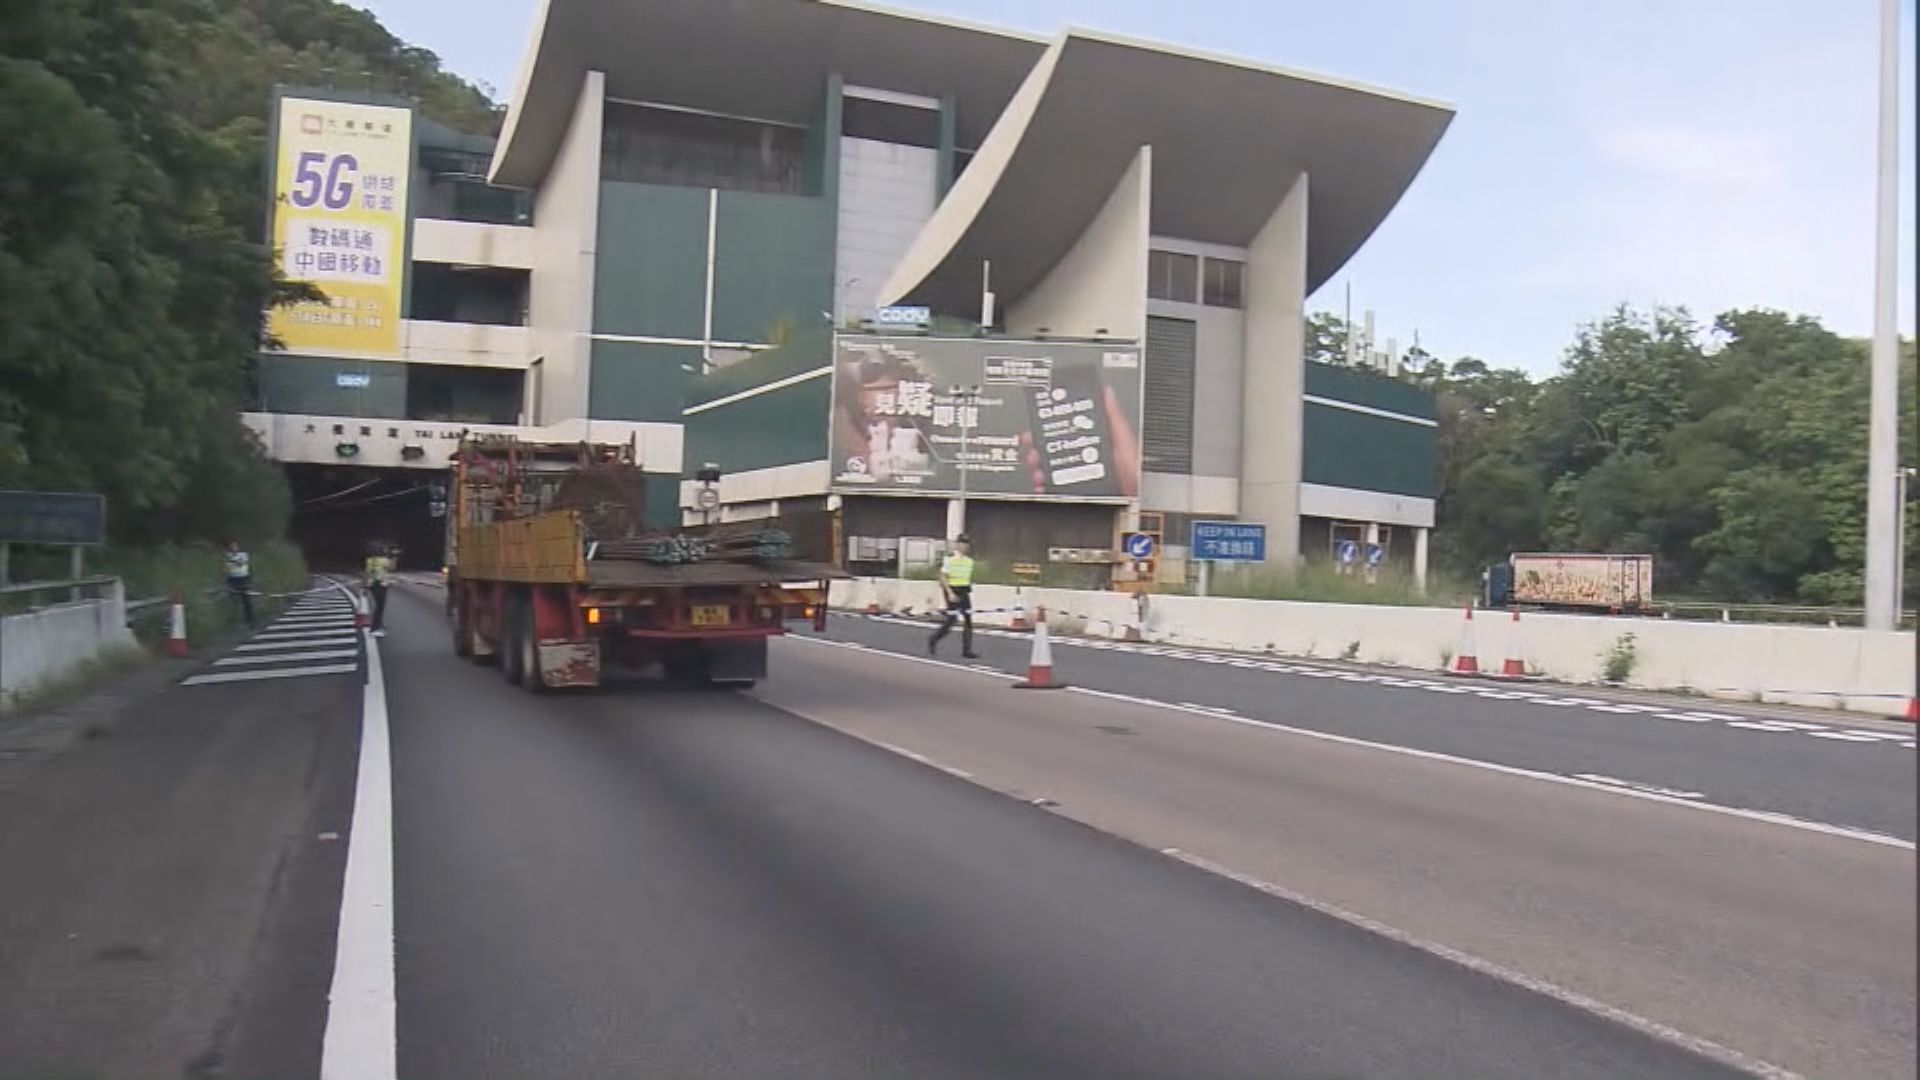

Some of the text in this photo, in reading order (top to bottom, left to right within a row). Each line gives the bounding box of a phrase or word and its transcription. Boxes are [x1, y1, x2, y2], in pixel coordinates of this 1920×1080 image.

[292, 152, 358, 209] 5G
[309, 227, 374, 249] 數碼通
[295, 252, 381, 275] 中國移動
[415, 430, 433, 439] TAI
